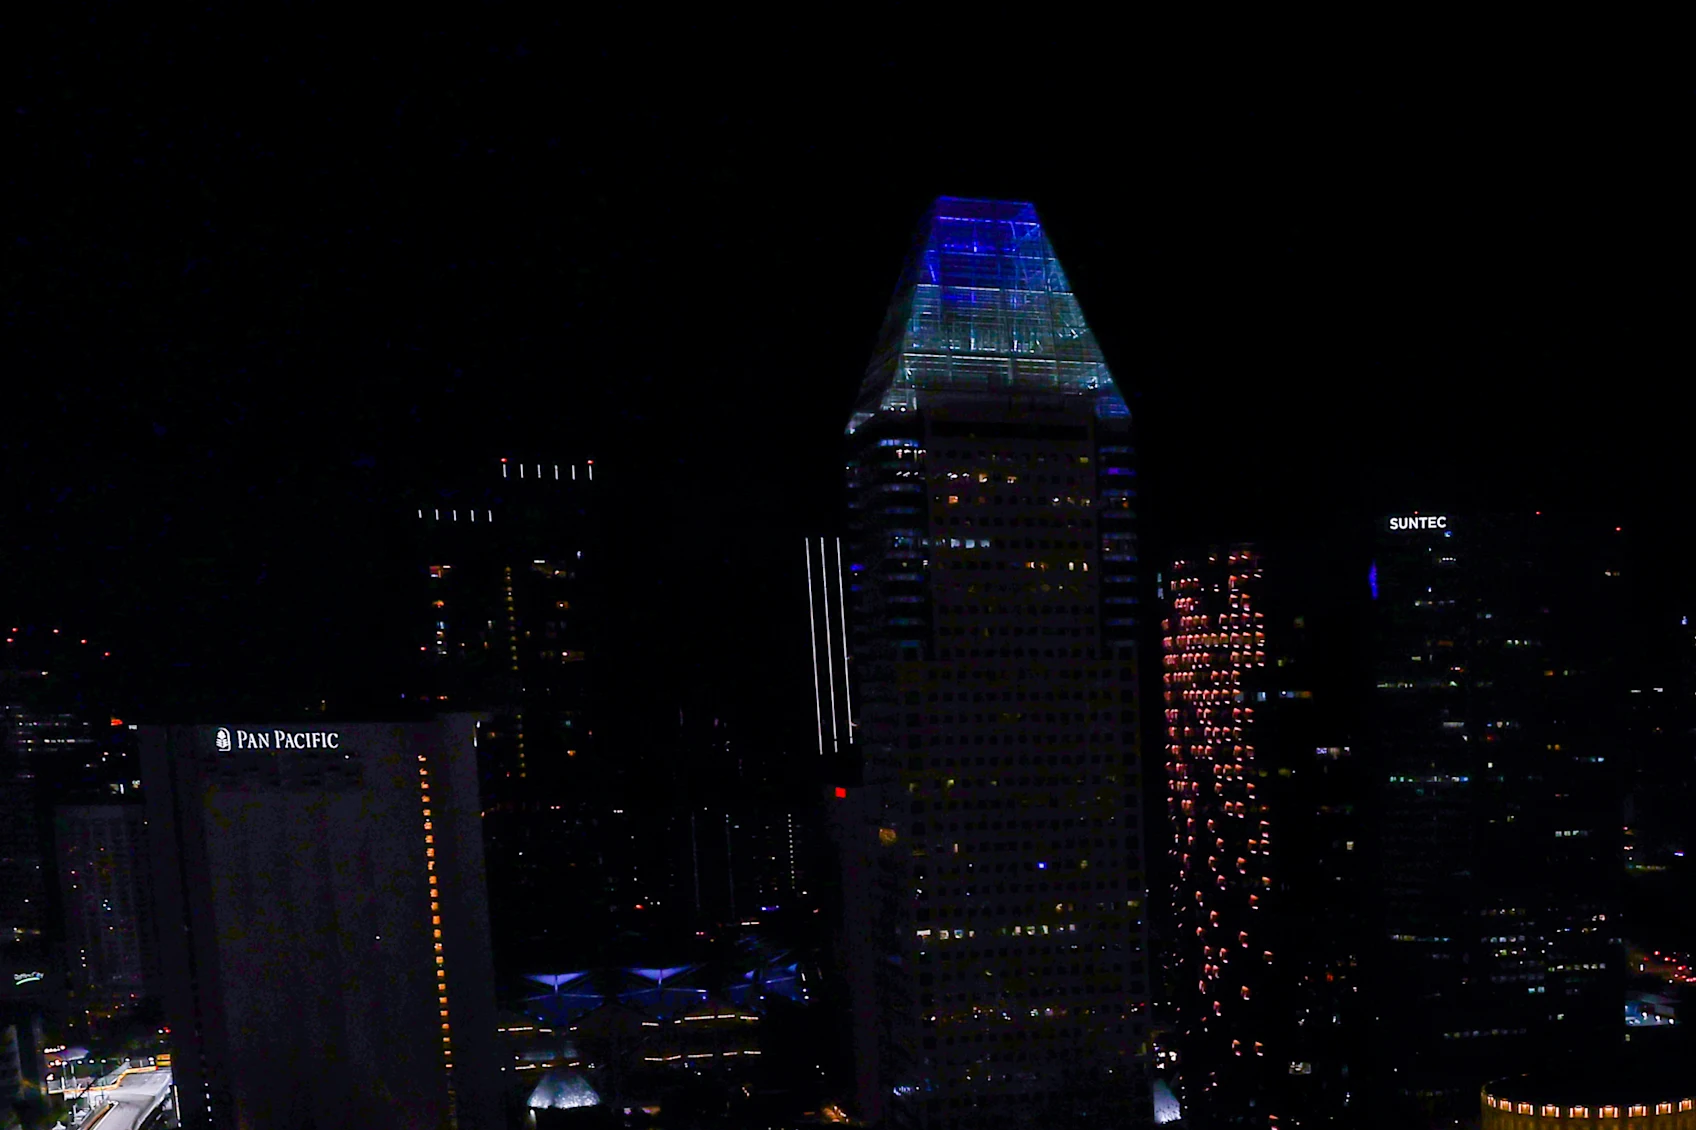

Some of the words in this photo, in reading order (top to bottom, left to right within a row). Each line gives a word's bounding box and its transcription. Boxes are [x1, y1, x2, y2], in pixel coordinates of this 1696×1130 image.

[1389, 516, 1447, 530] SUNTEC
[236, 730, 271, 750] PAN
[274, 730, 339, 750] PACIFIC
